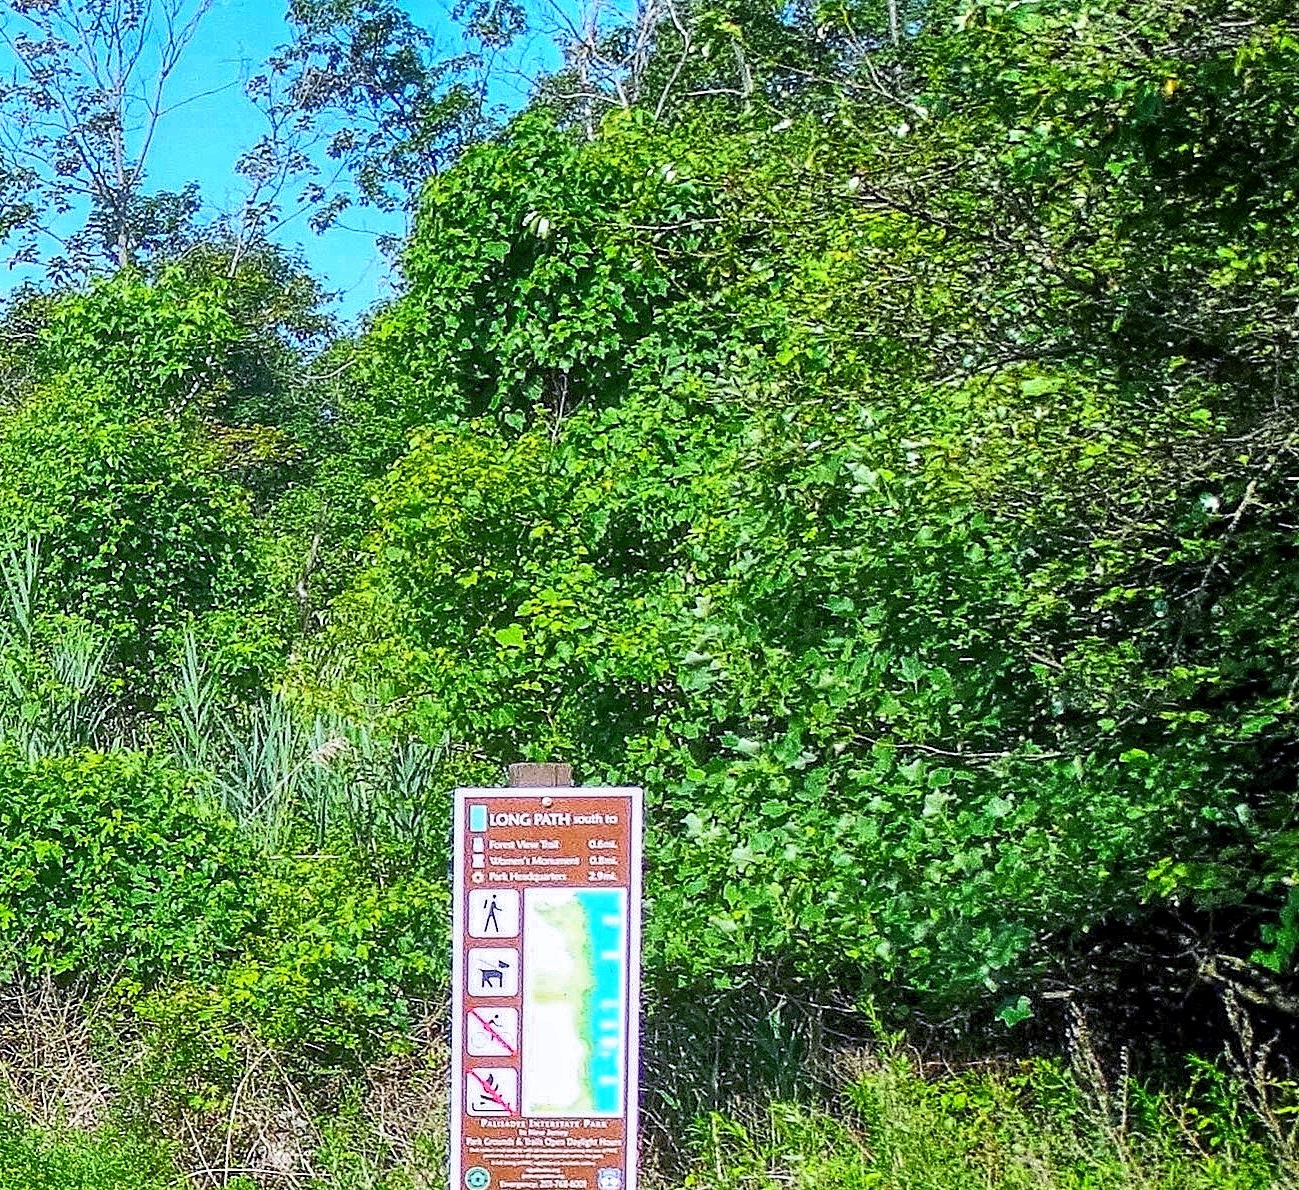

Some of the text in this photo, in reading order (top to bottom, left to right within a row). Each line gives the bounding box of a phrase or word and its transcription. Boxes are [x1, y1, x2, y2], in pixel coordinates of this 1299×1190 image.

[489, 813, 618, 827] LONG PATH south to
[489, 840, 515, 849] Forest
[516, 840, 539, 849] View
[531, 856, 581, 866] Monument
